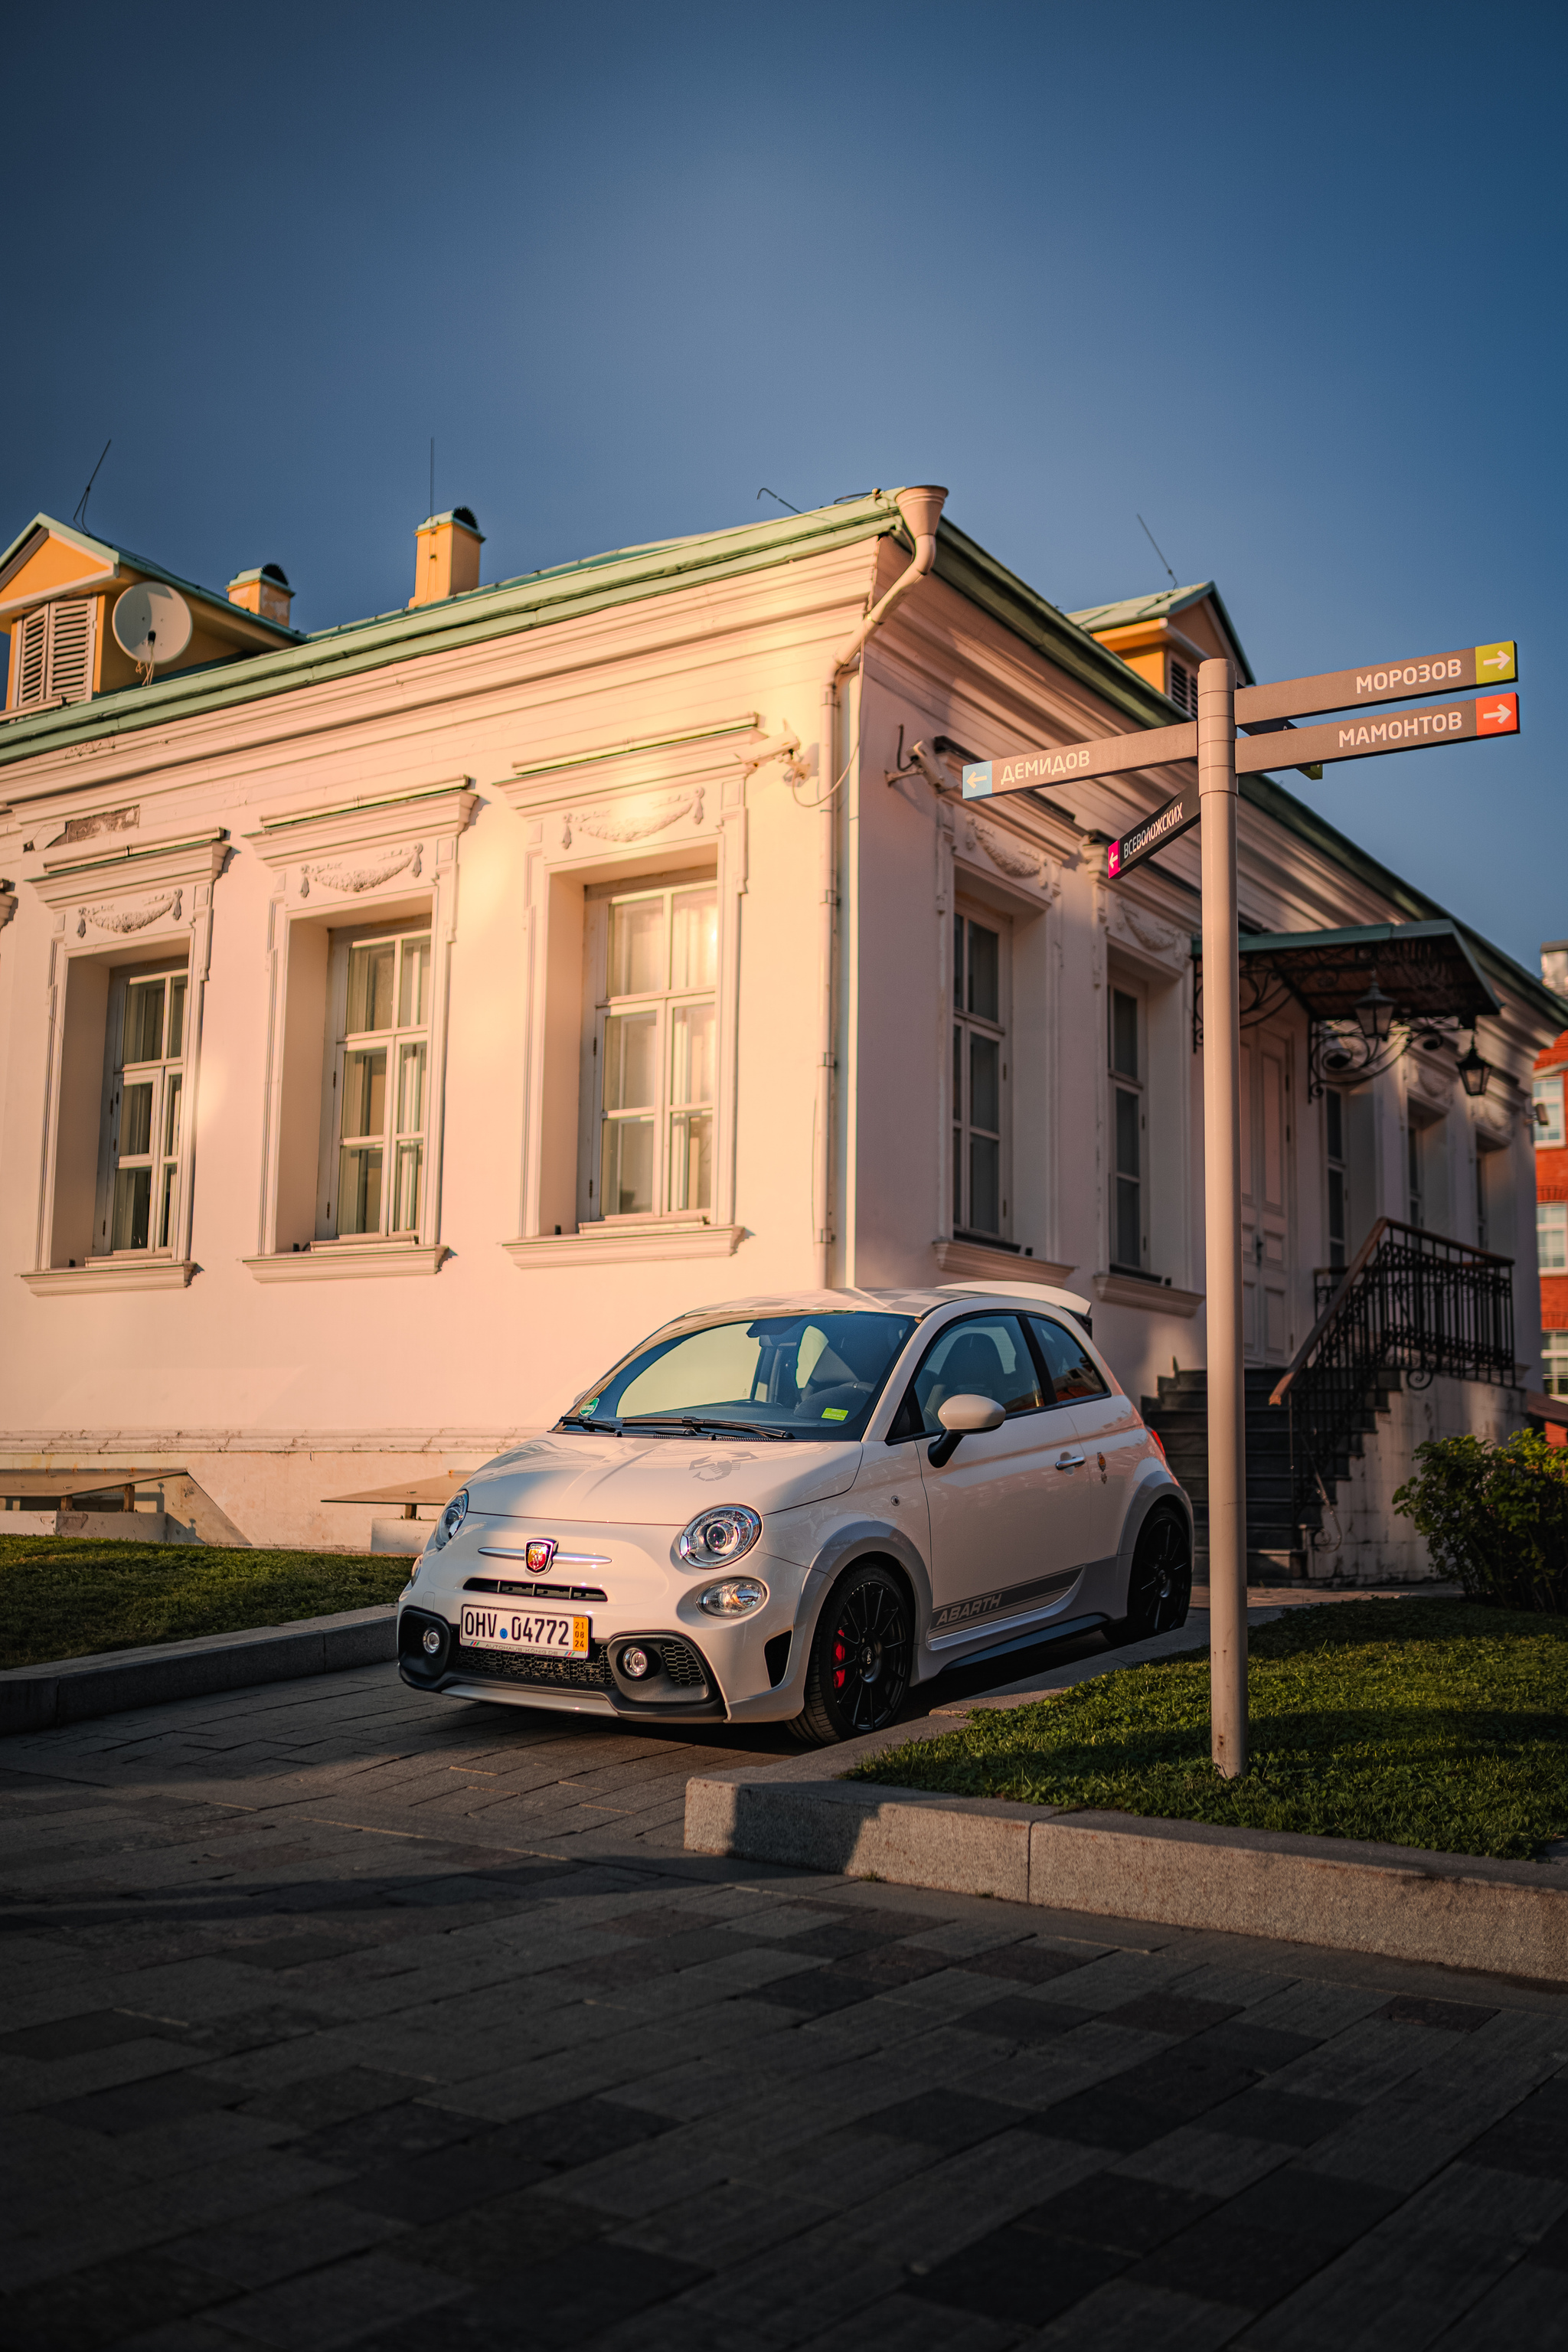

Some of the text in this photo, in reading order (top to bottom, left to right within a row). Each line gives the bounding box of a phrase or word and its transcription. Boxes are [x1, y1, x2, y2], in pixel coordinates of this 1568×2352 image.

[1356, 658, 1462, 694] МОРОЗОВ
[1338, 711, 1462, 748] МАМОНТОВ
[1000, 750, 1089, 786] ДЕМИДОВ
[1123, 802, 1183, 859] ВСЕВОЛОЖСКИХ
[575, 1621, 584, 1629] 21
[936, 1593, 1002, 1626] ABARTH
[465, 1611, 569, 1645] OHV 04772
